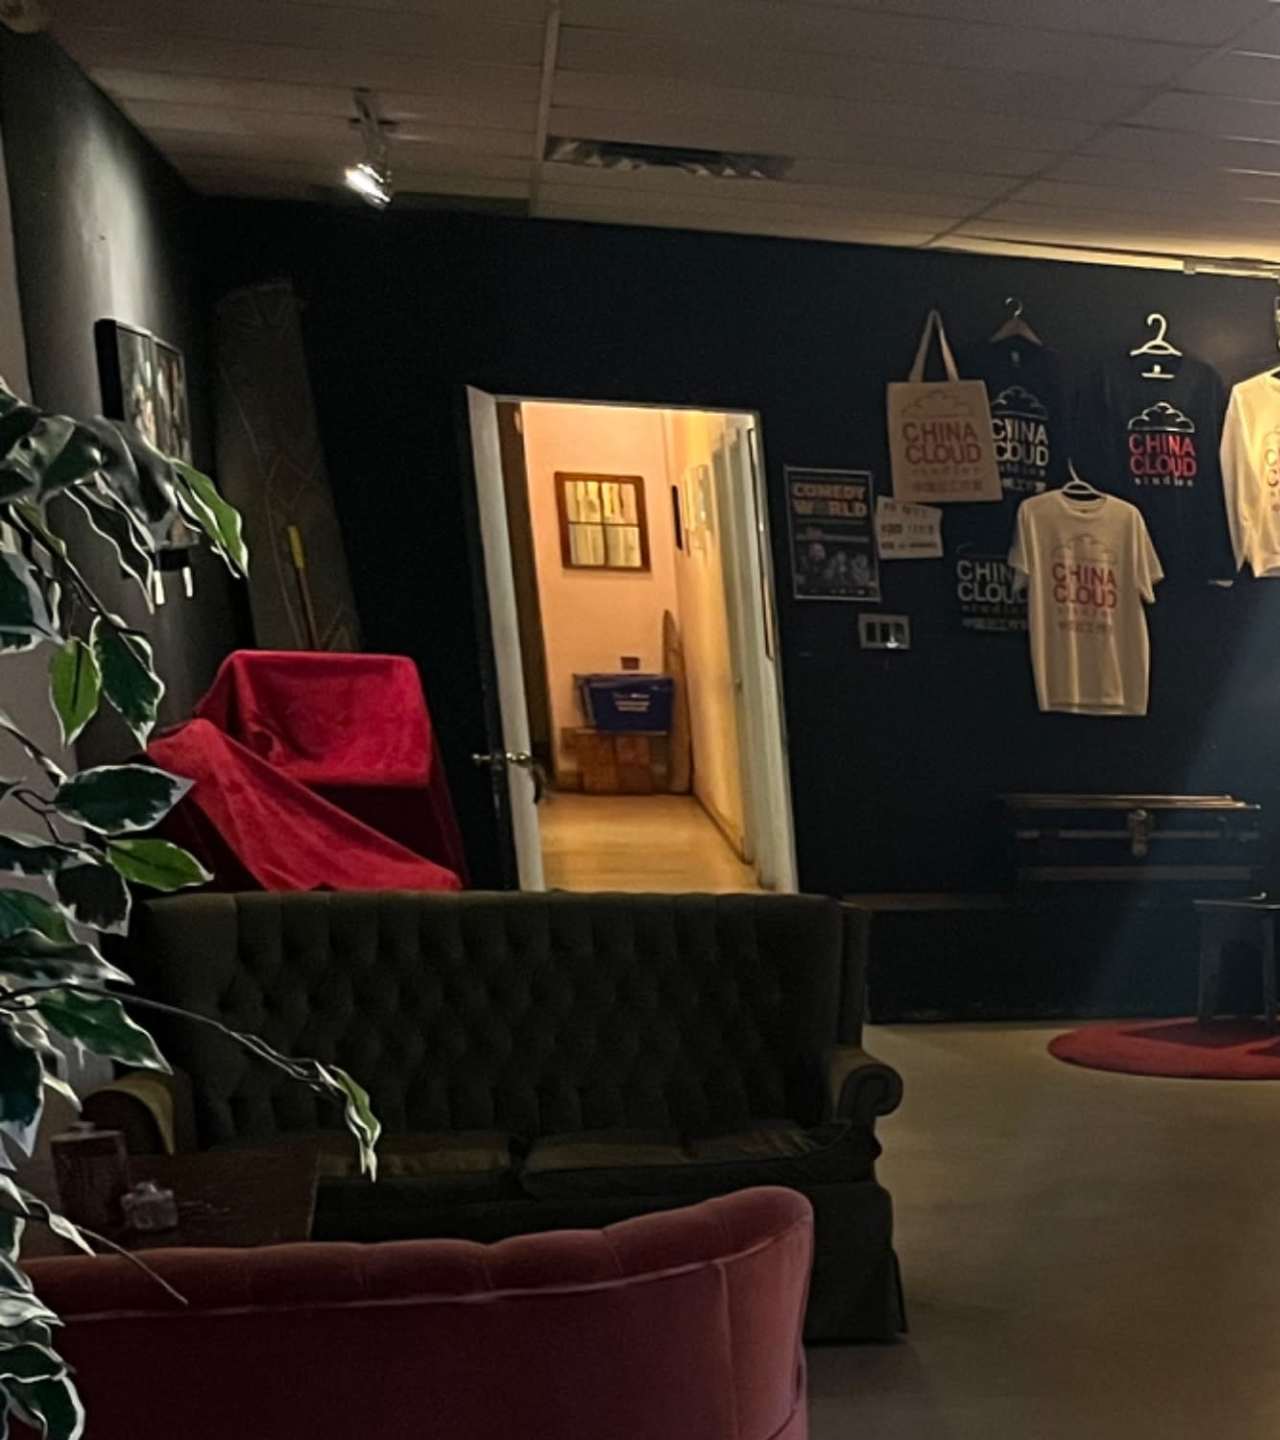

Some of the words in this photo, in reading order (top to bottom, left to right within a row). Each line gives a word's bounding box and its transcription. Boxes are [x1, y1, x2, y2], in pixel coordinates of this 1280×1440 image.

[902, 421, 978, 444] CHINA
[905, 443, 982, 465] CLOUD
[993, 440, 1050, 467] COUD
[1129, 433, 1196, 457] CHINA
[1130, 455, 1197, 478] CLOUD
[956, 559, 1014, 584] CHIN
[1052, 562, 1117, 589] CHINA
[1054, 583, 1118, 609] CLOUD
